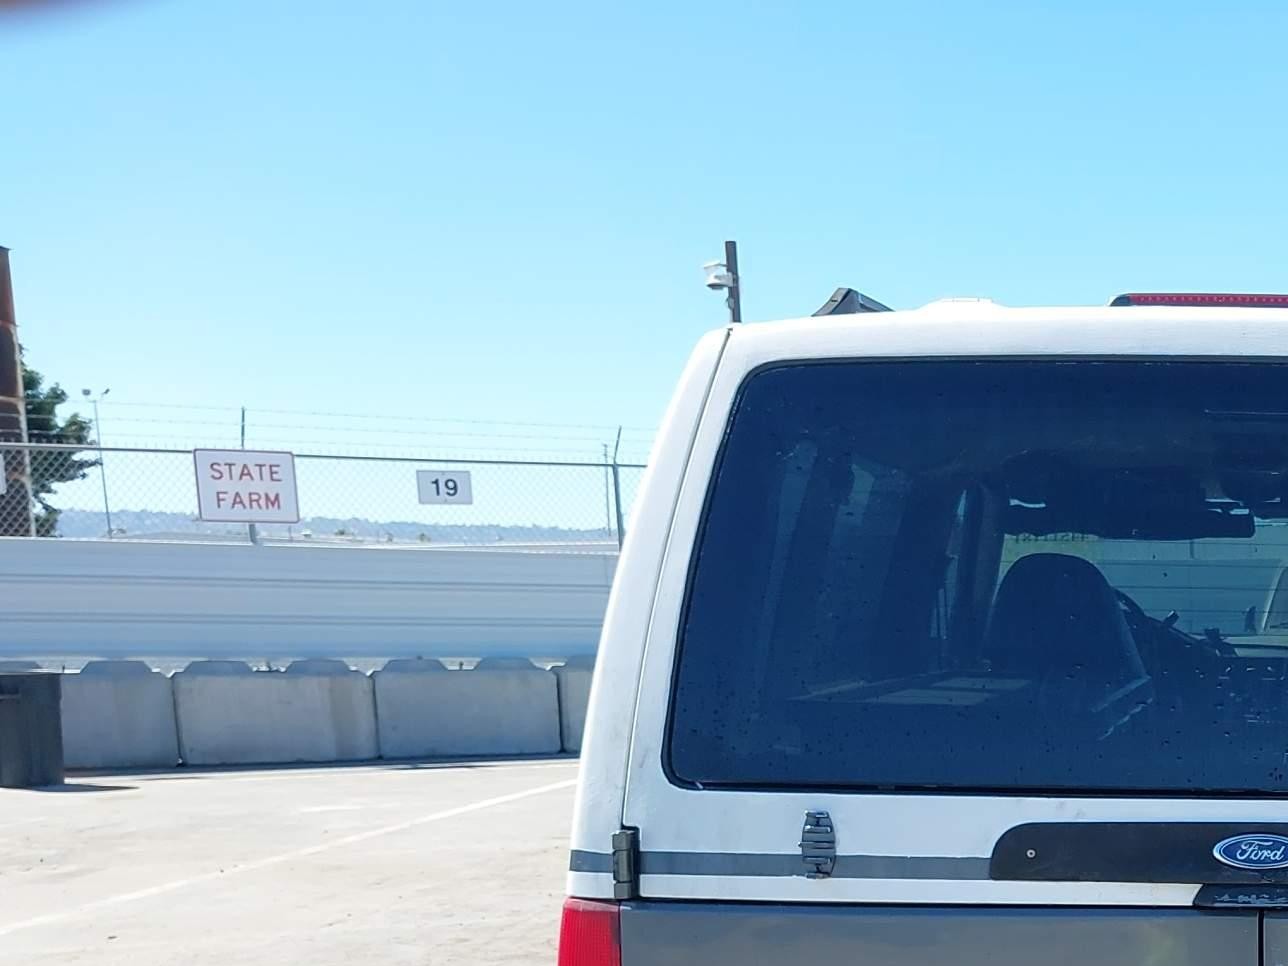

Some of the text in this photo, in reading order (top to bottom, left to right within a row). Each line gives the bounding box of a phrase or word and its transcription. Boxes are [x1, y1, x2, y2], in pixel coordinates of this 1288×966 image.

[210, 462, 282, 482] STATE
[430, 478, 458, 496] 19
[216, 491, 281, 510] FARM
[1236, 840, 1285, 861] Ford
